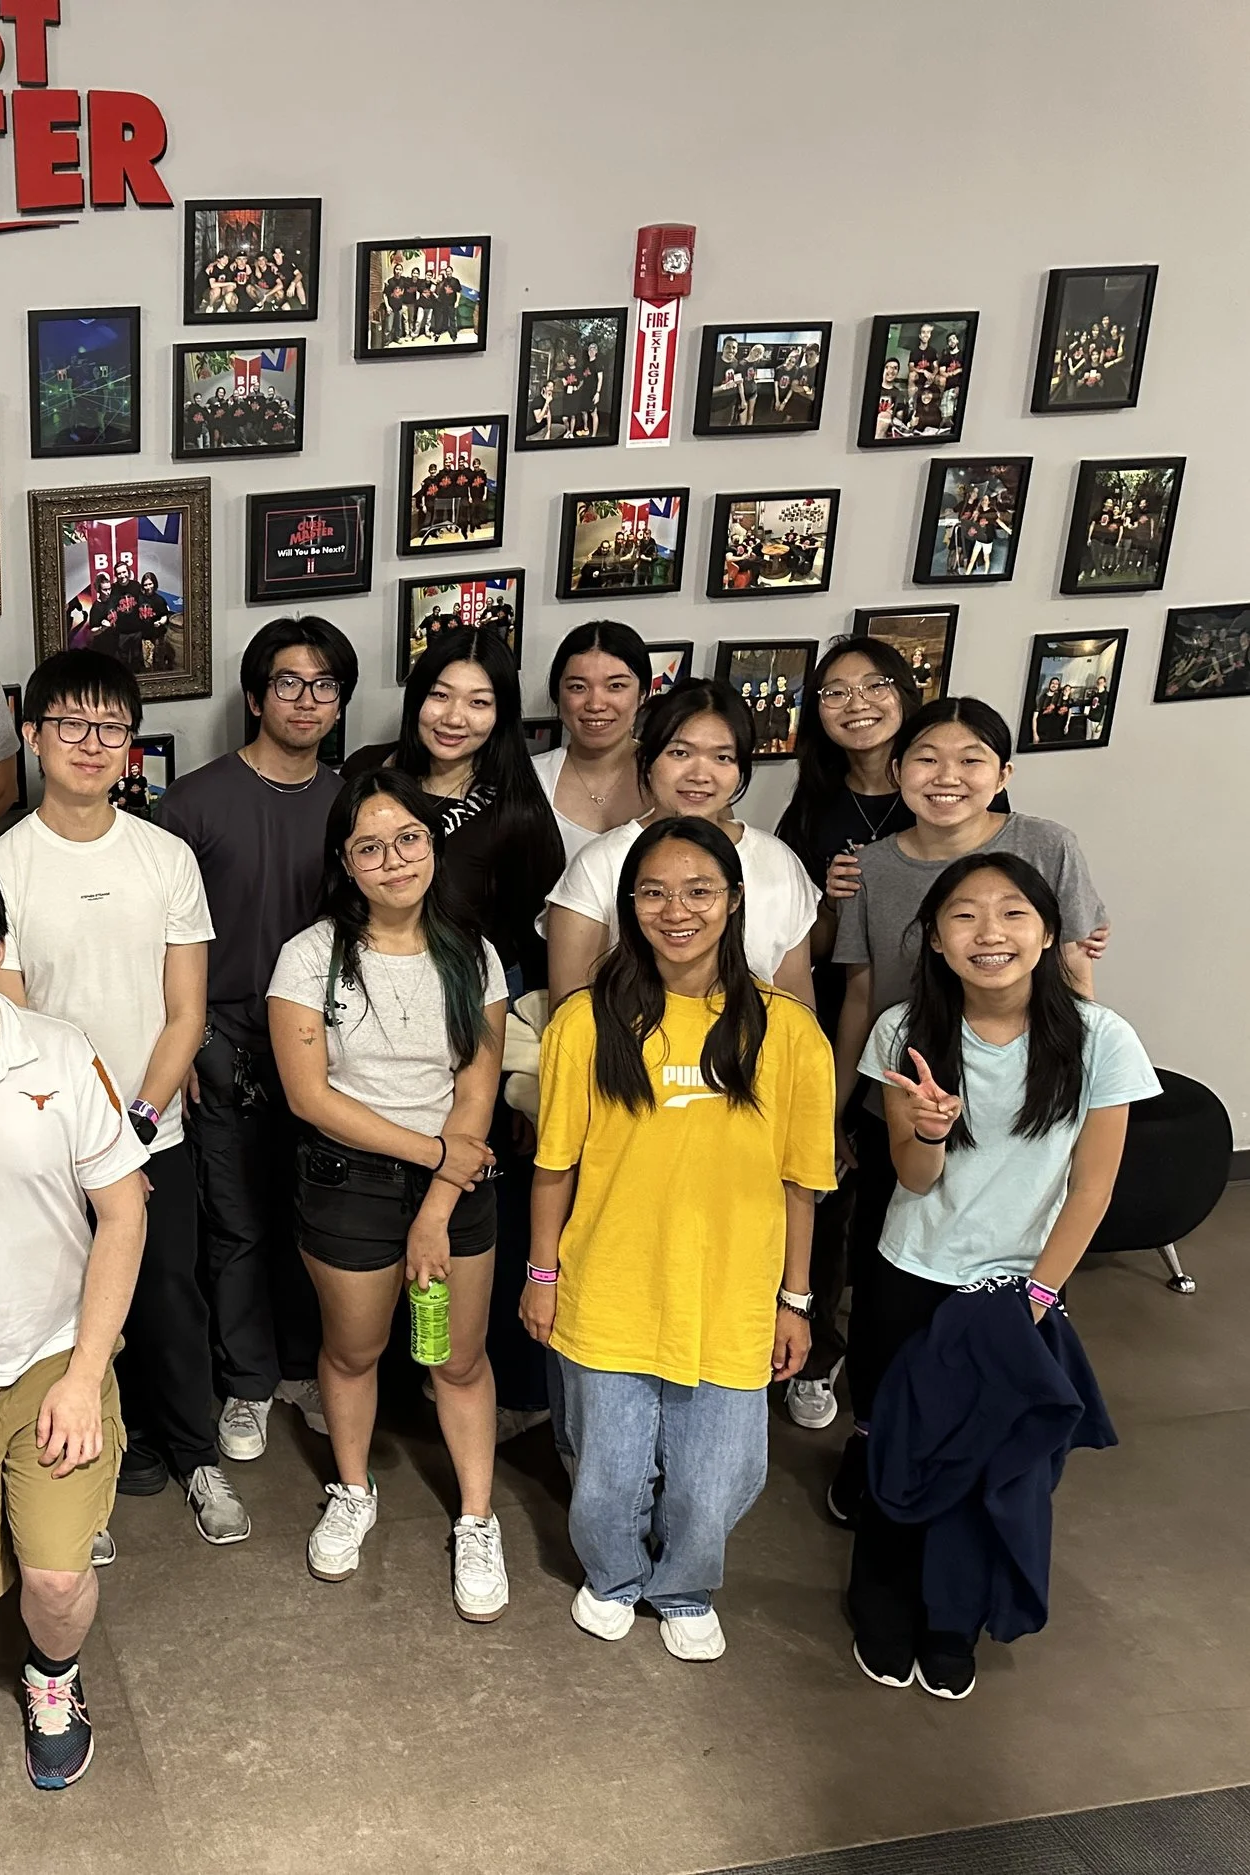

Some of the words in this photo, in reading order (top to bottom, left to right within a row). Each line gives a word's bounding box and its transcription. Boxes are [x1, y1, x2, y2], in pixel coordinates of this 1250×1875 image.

[646, 311, 670, 328] FIRE
[644, 330, 663, 425] EXTINGUISHER
[297, 520, 327, 531] QUEST
[289, 527, 334, 546] MASTER
[277, 549, 293, 557] Will
[294, 548, 308, 556] You
[310, 547, 321, 555] Be
[322, 545, 346, 554] Next?
[662, 1065, 708, 1087] PUM
